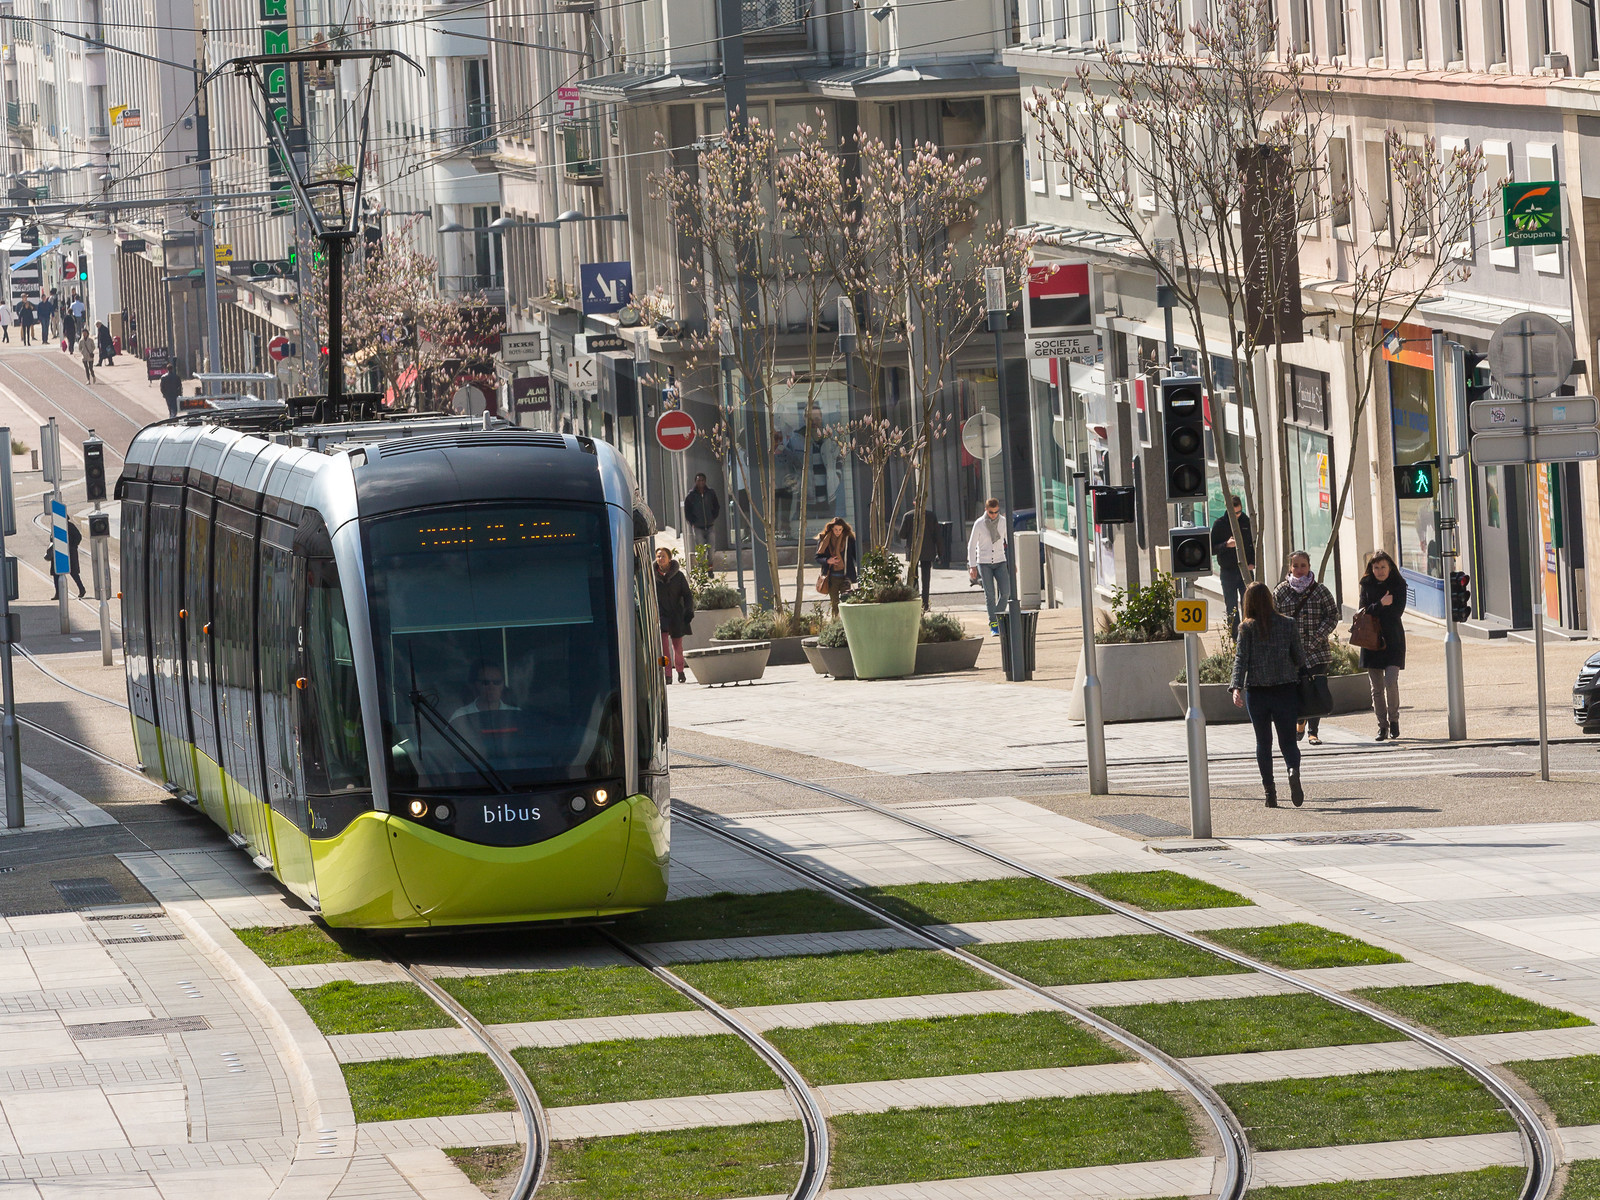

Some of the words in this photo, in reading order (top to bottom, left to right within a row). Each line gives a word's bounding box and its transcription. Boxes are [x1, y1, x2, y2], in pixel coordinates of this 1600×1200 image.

[1512, 231, 1556, 240] Groupama
[1034, 338, 1080, 349] SOCIETE
[1034, 345, 1091, 357] GENERALE
[1181, 607, 1203, 624] 30
[483, 803, 541, 824] bibus
